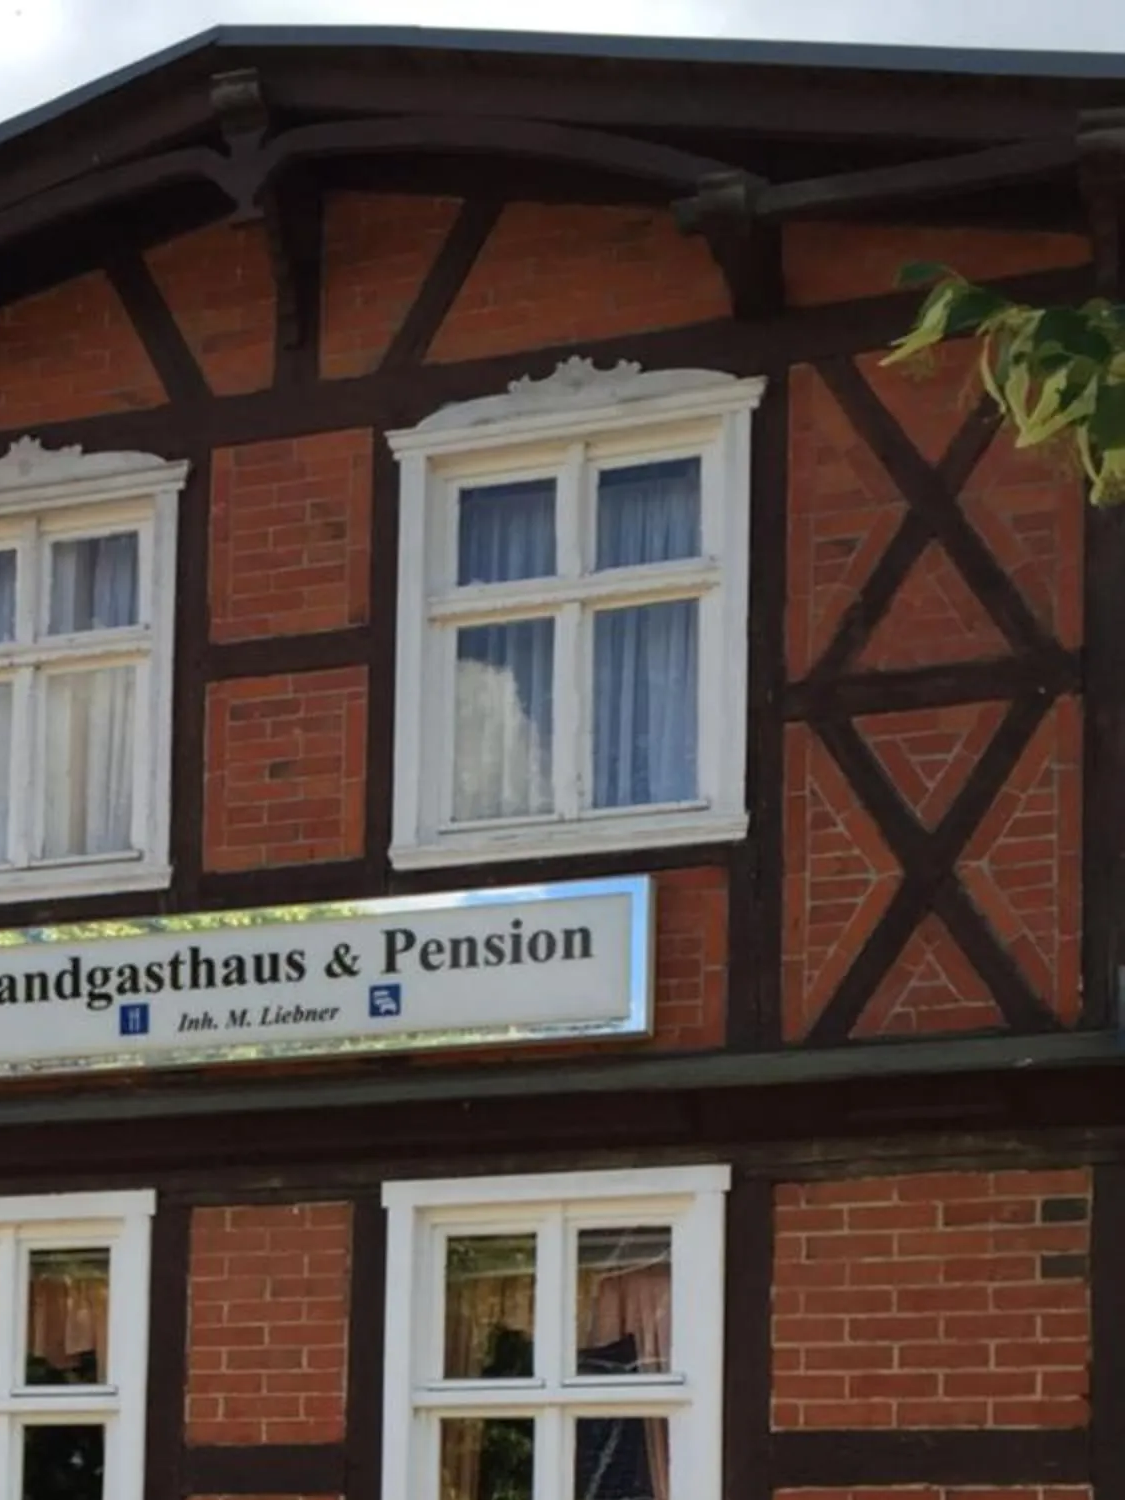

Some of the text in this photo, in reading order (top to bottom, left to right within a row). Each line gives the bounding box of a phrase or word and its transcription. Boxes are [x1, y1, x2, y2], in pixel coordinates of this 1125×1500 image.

[323, 942, 360, 978] &
[380, 918, 593, 974] Pension
[177, 1003, 340, 1032] Inh. M. Liebner
